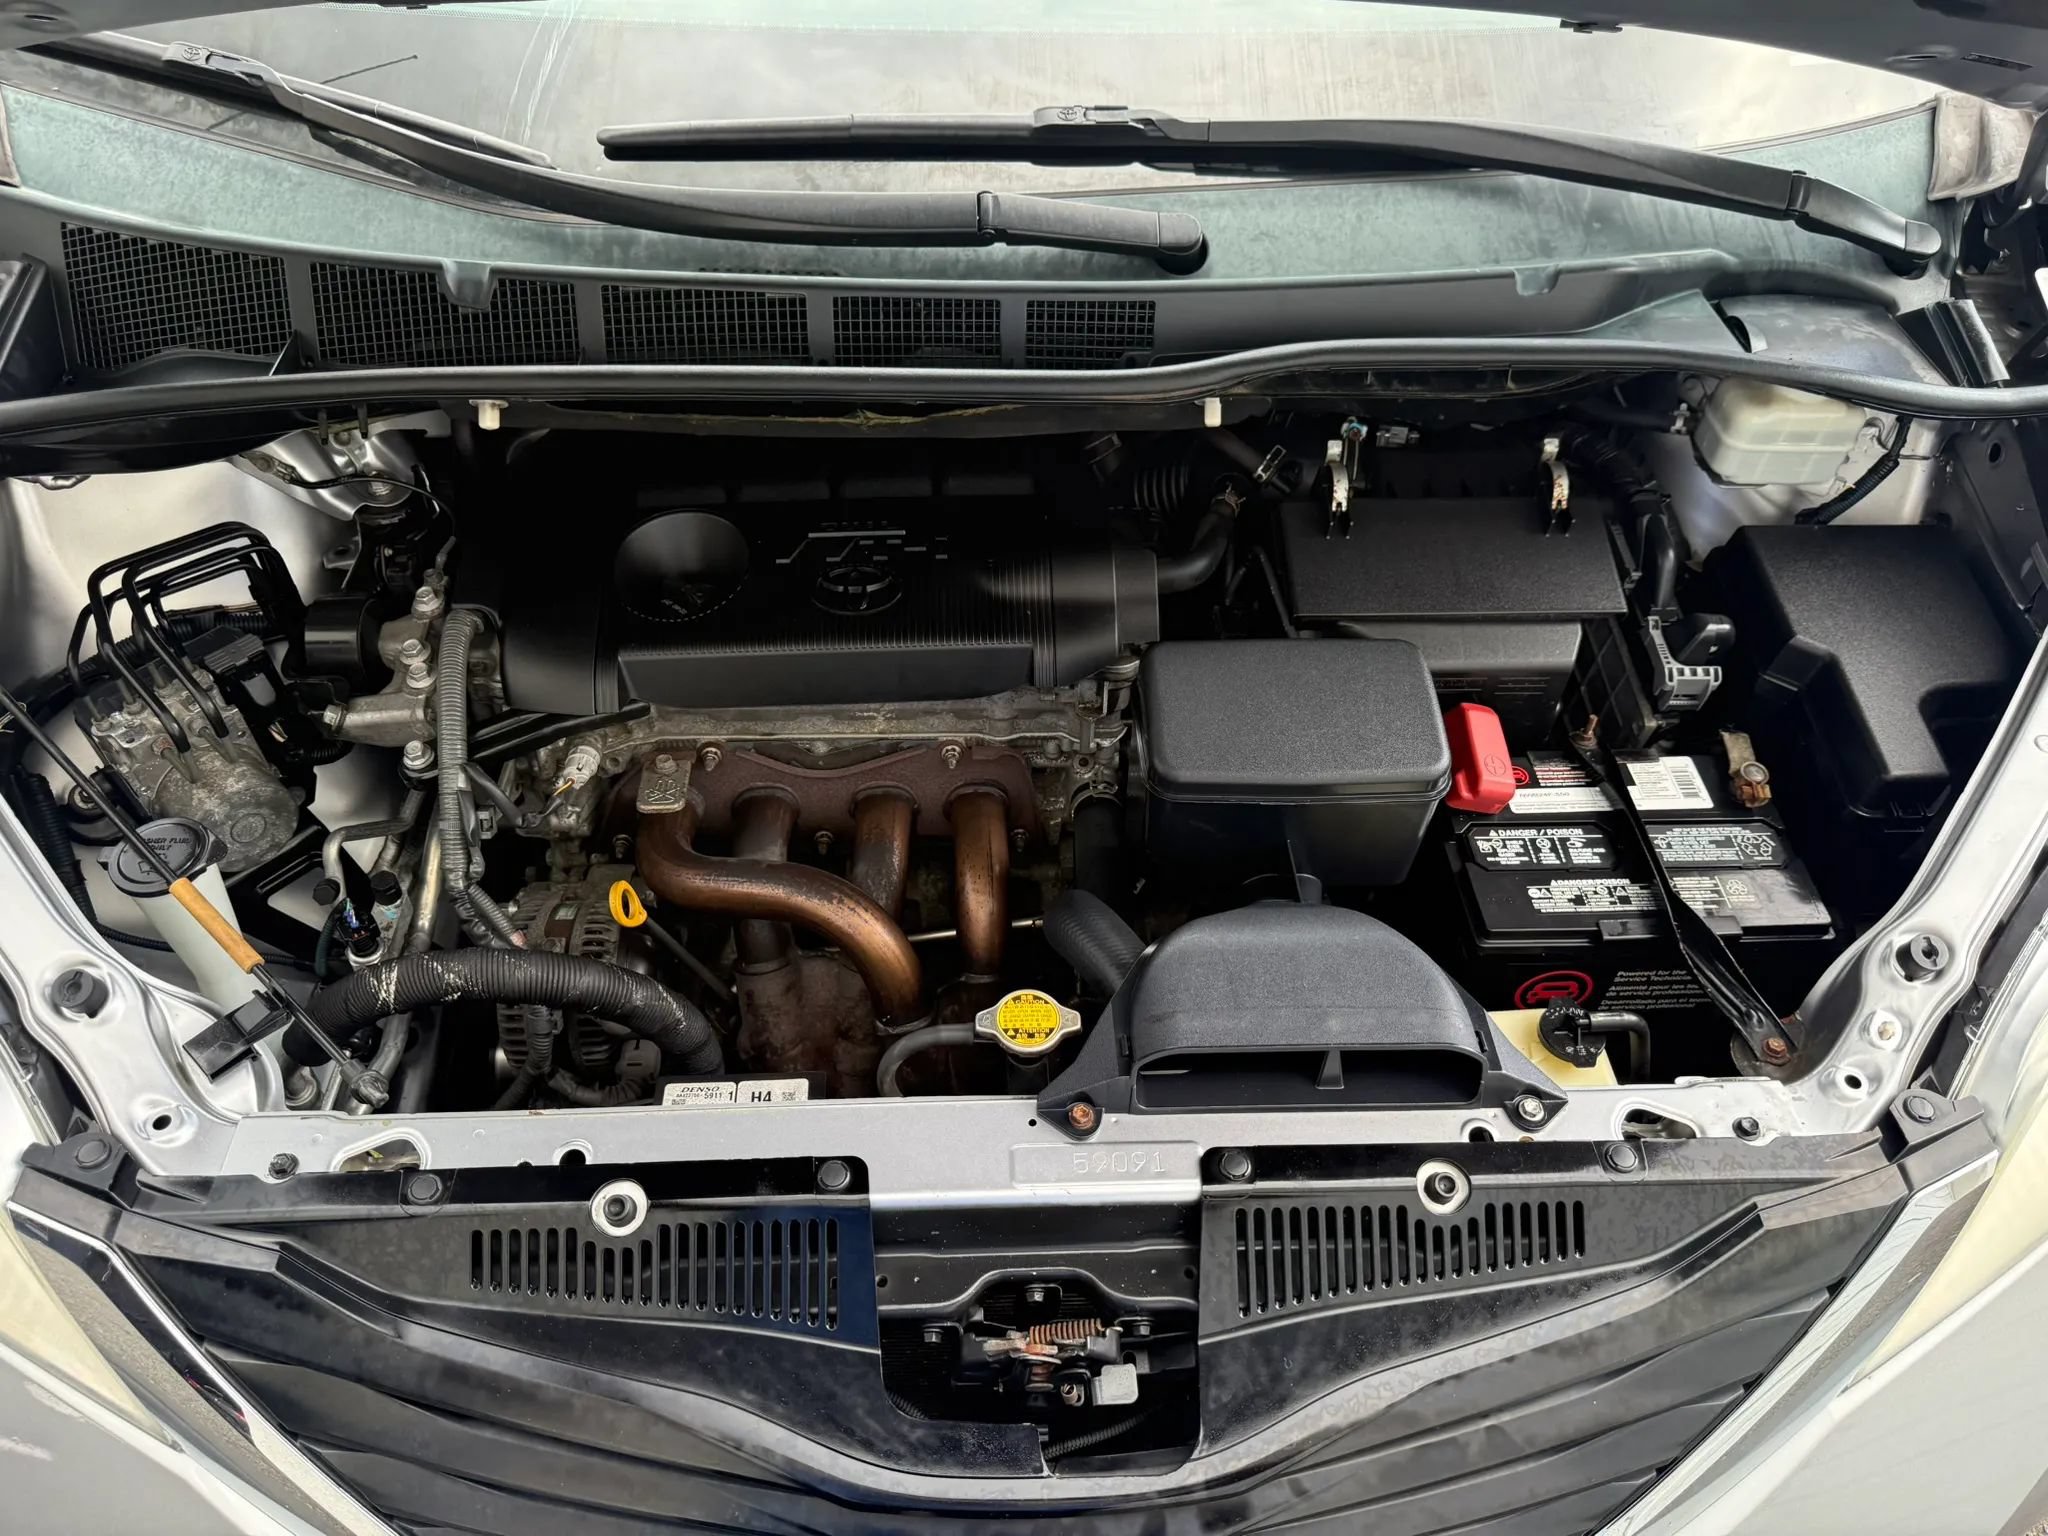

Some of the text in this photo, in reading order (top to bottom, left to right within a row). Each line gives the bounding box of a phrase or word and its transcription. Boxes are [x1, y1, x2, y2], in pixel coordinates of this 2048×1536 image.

[1498, 829, 1538, 837] DANGER
[1547, 828, 1584, 836] POISON
[751, 1091, 773, 1103] H4
